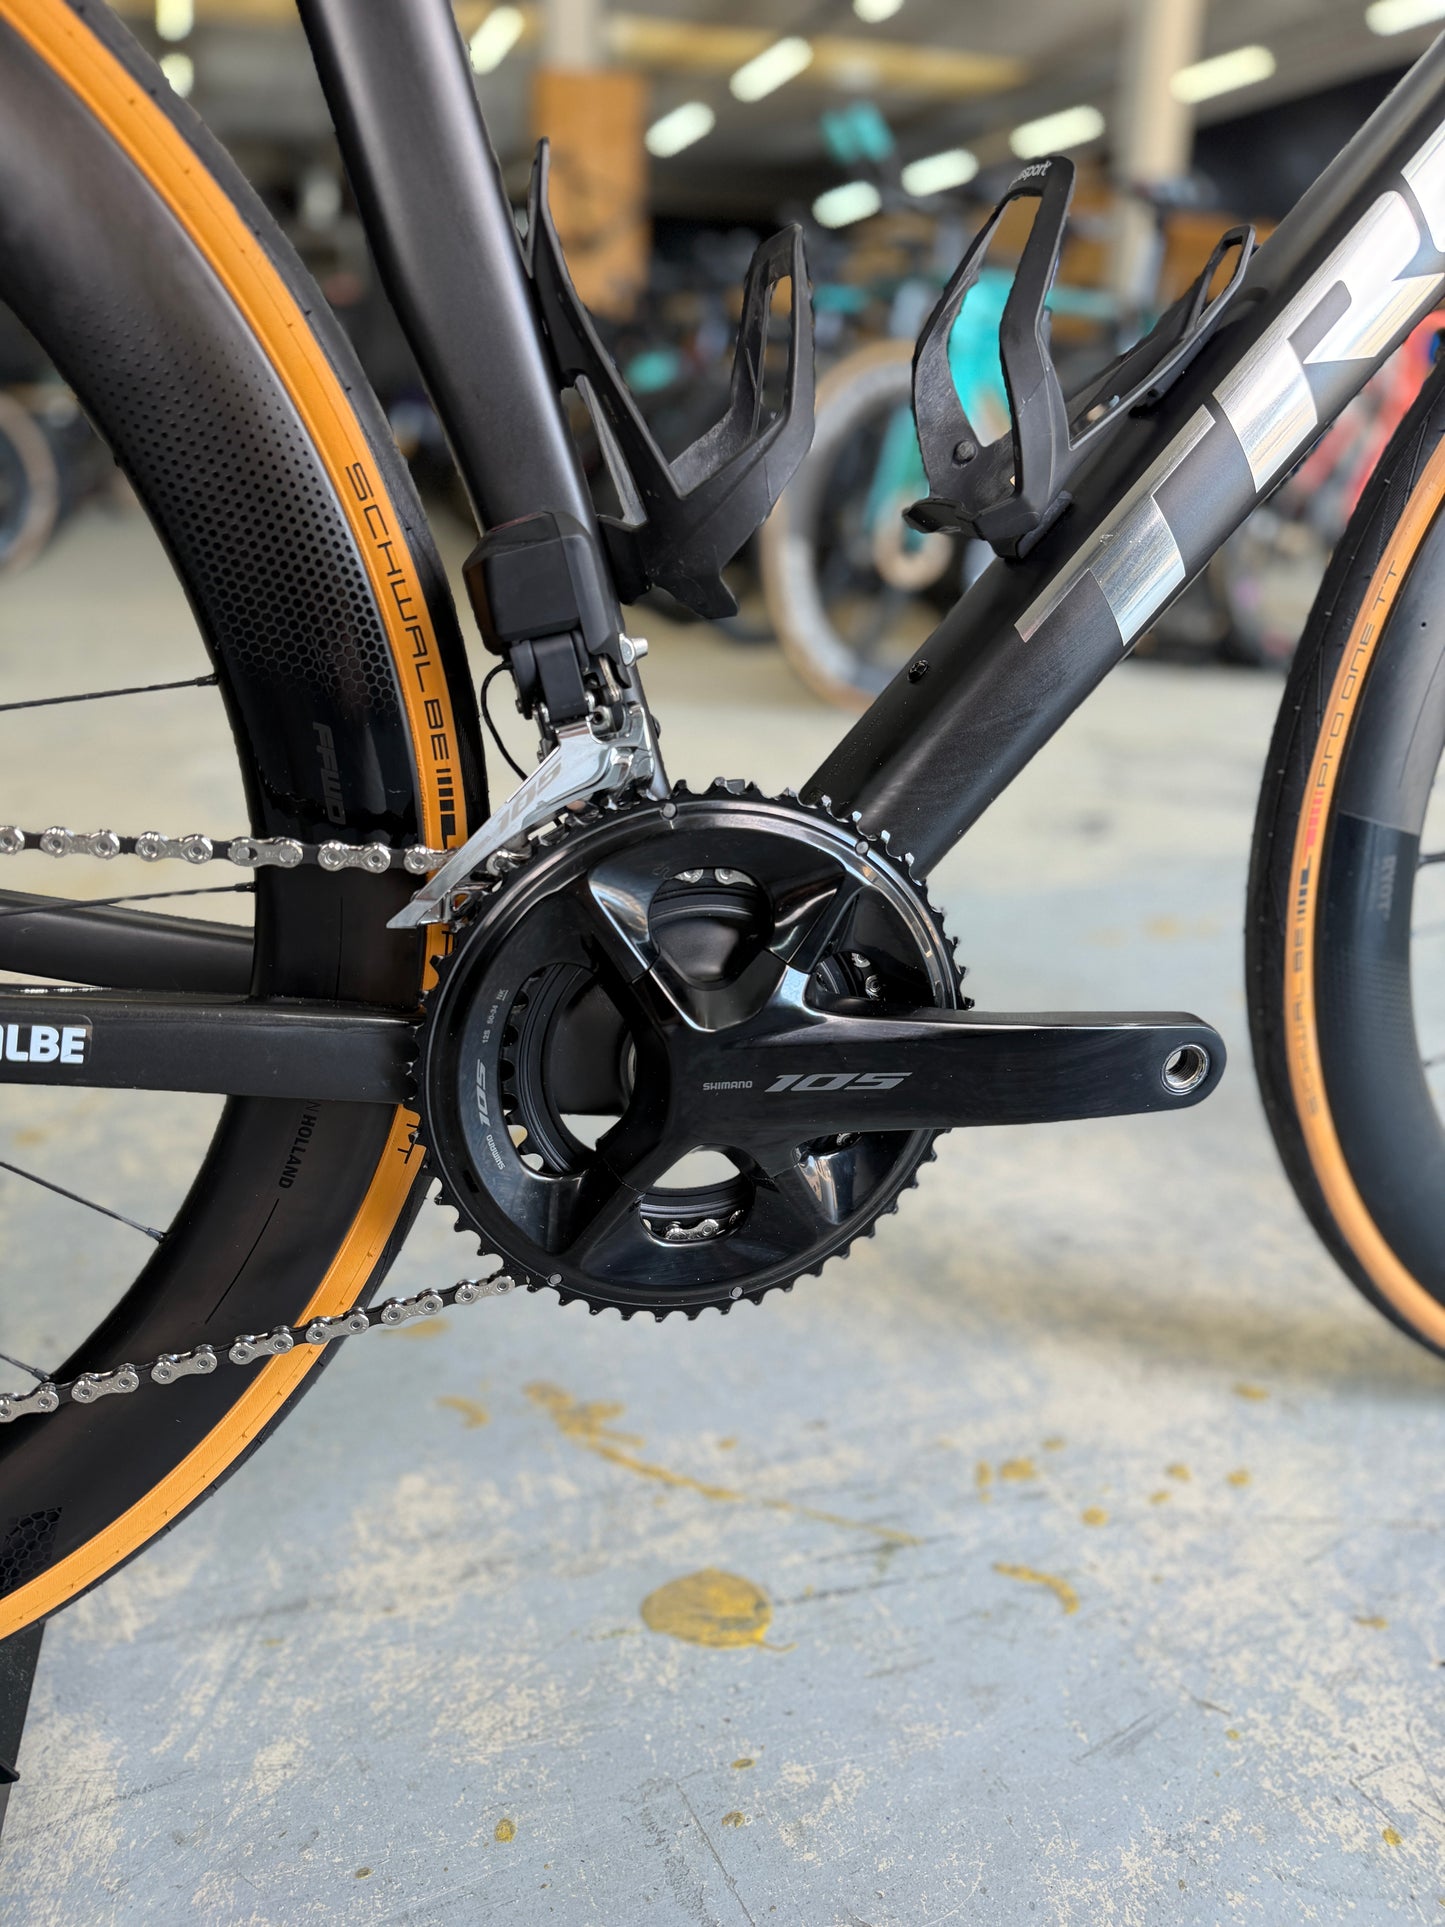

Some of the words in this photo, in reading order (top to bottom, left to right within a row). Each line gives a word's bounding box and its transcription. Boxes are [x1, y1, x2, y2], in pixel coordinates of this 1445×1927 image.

[1014, 116, 1445, 647] TR
[345, 462, 450, 761] SCHWALBE
[1372, 559, 1397, 611] TT
[312, 720, 347, 826] FFWD
[497, 755, 563, 834] 105
[0, 1023, 87, 1065] LBE
[476, 1058, 491, 1127] 105
[702, 1080, 753, 1091] SHIMANO
[764, 1071, 914, 1093] 105
[278, 1114, 318, 1189] HOLLAND
[486, 1134, 506, 1171] SHIMANO
